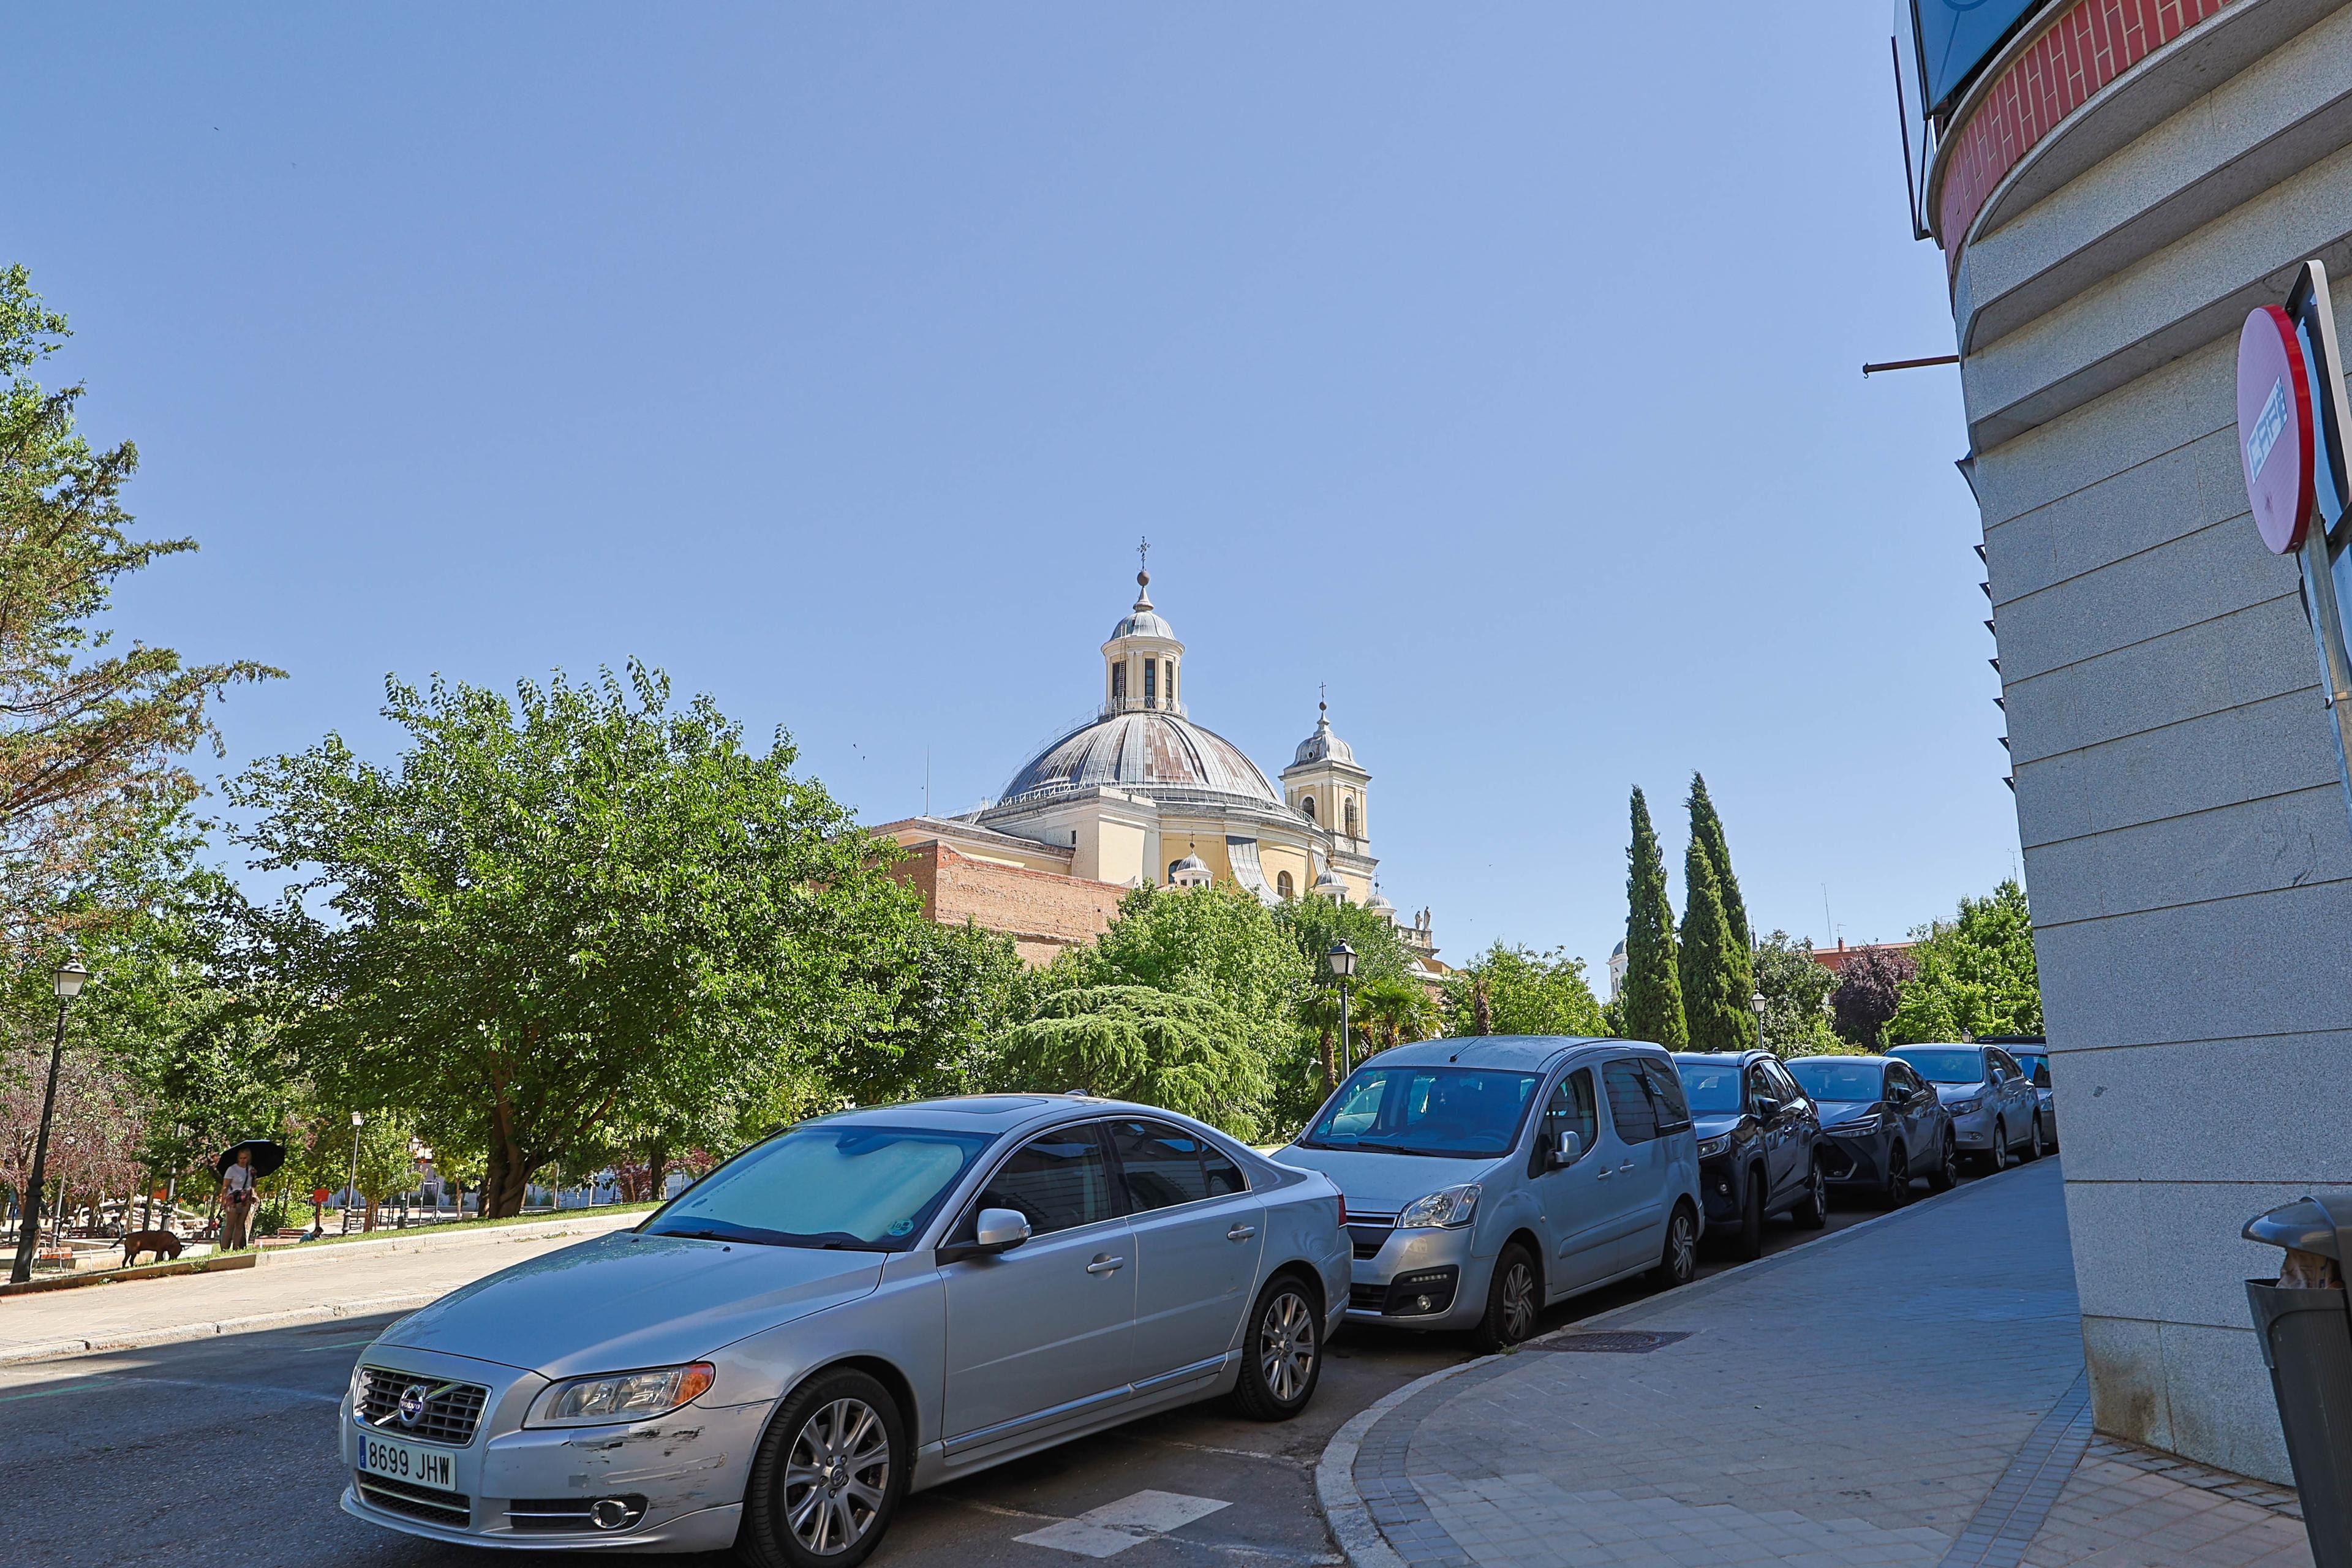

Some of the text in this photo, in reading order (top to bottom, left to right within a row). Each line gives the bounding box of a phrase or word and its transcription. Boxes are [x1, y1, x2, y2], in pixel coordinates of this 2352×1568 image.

[401, 1401, 420, 1409] VOLVO
[369, 1442, 449, 1485] 8699 JHW
